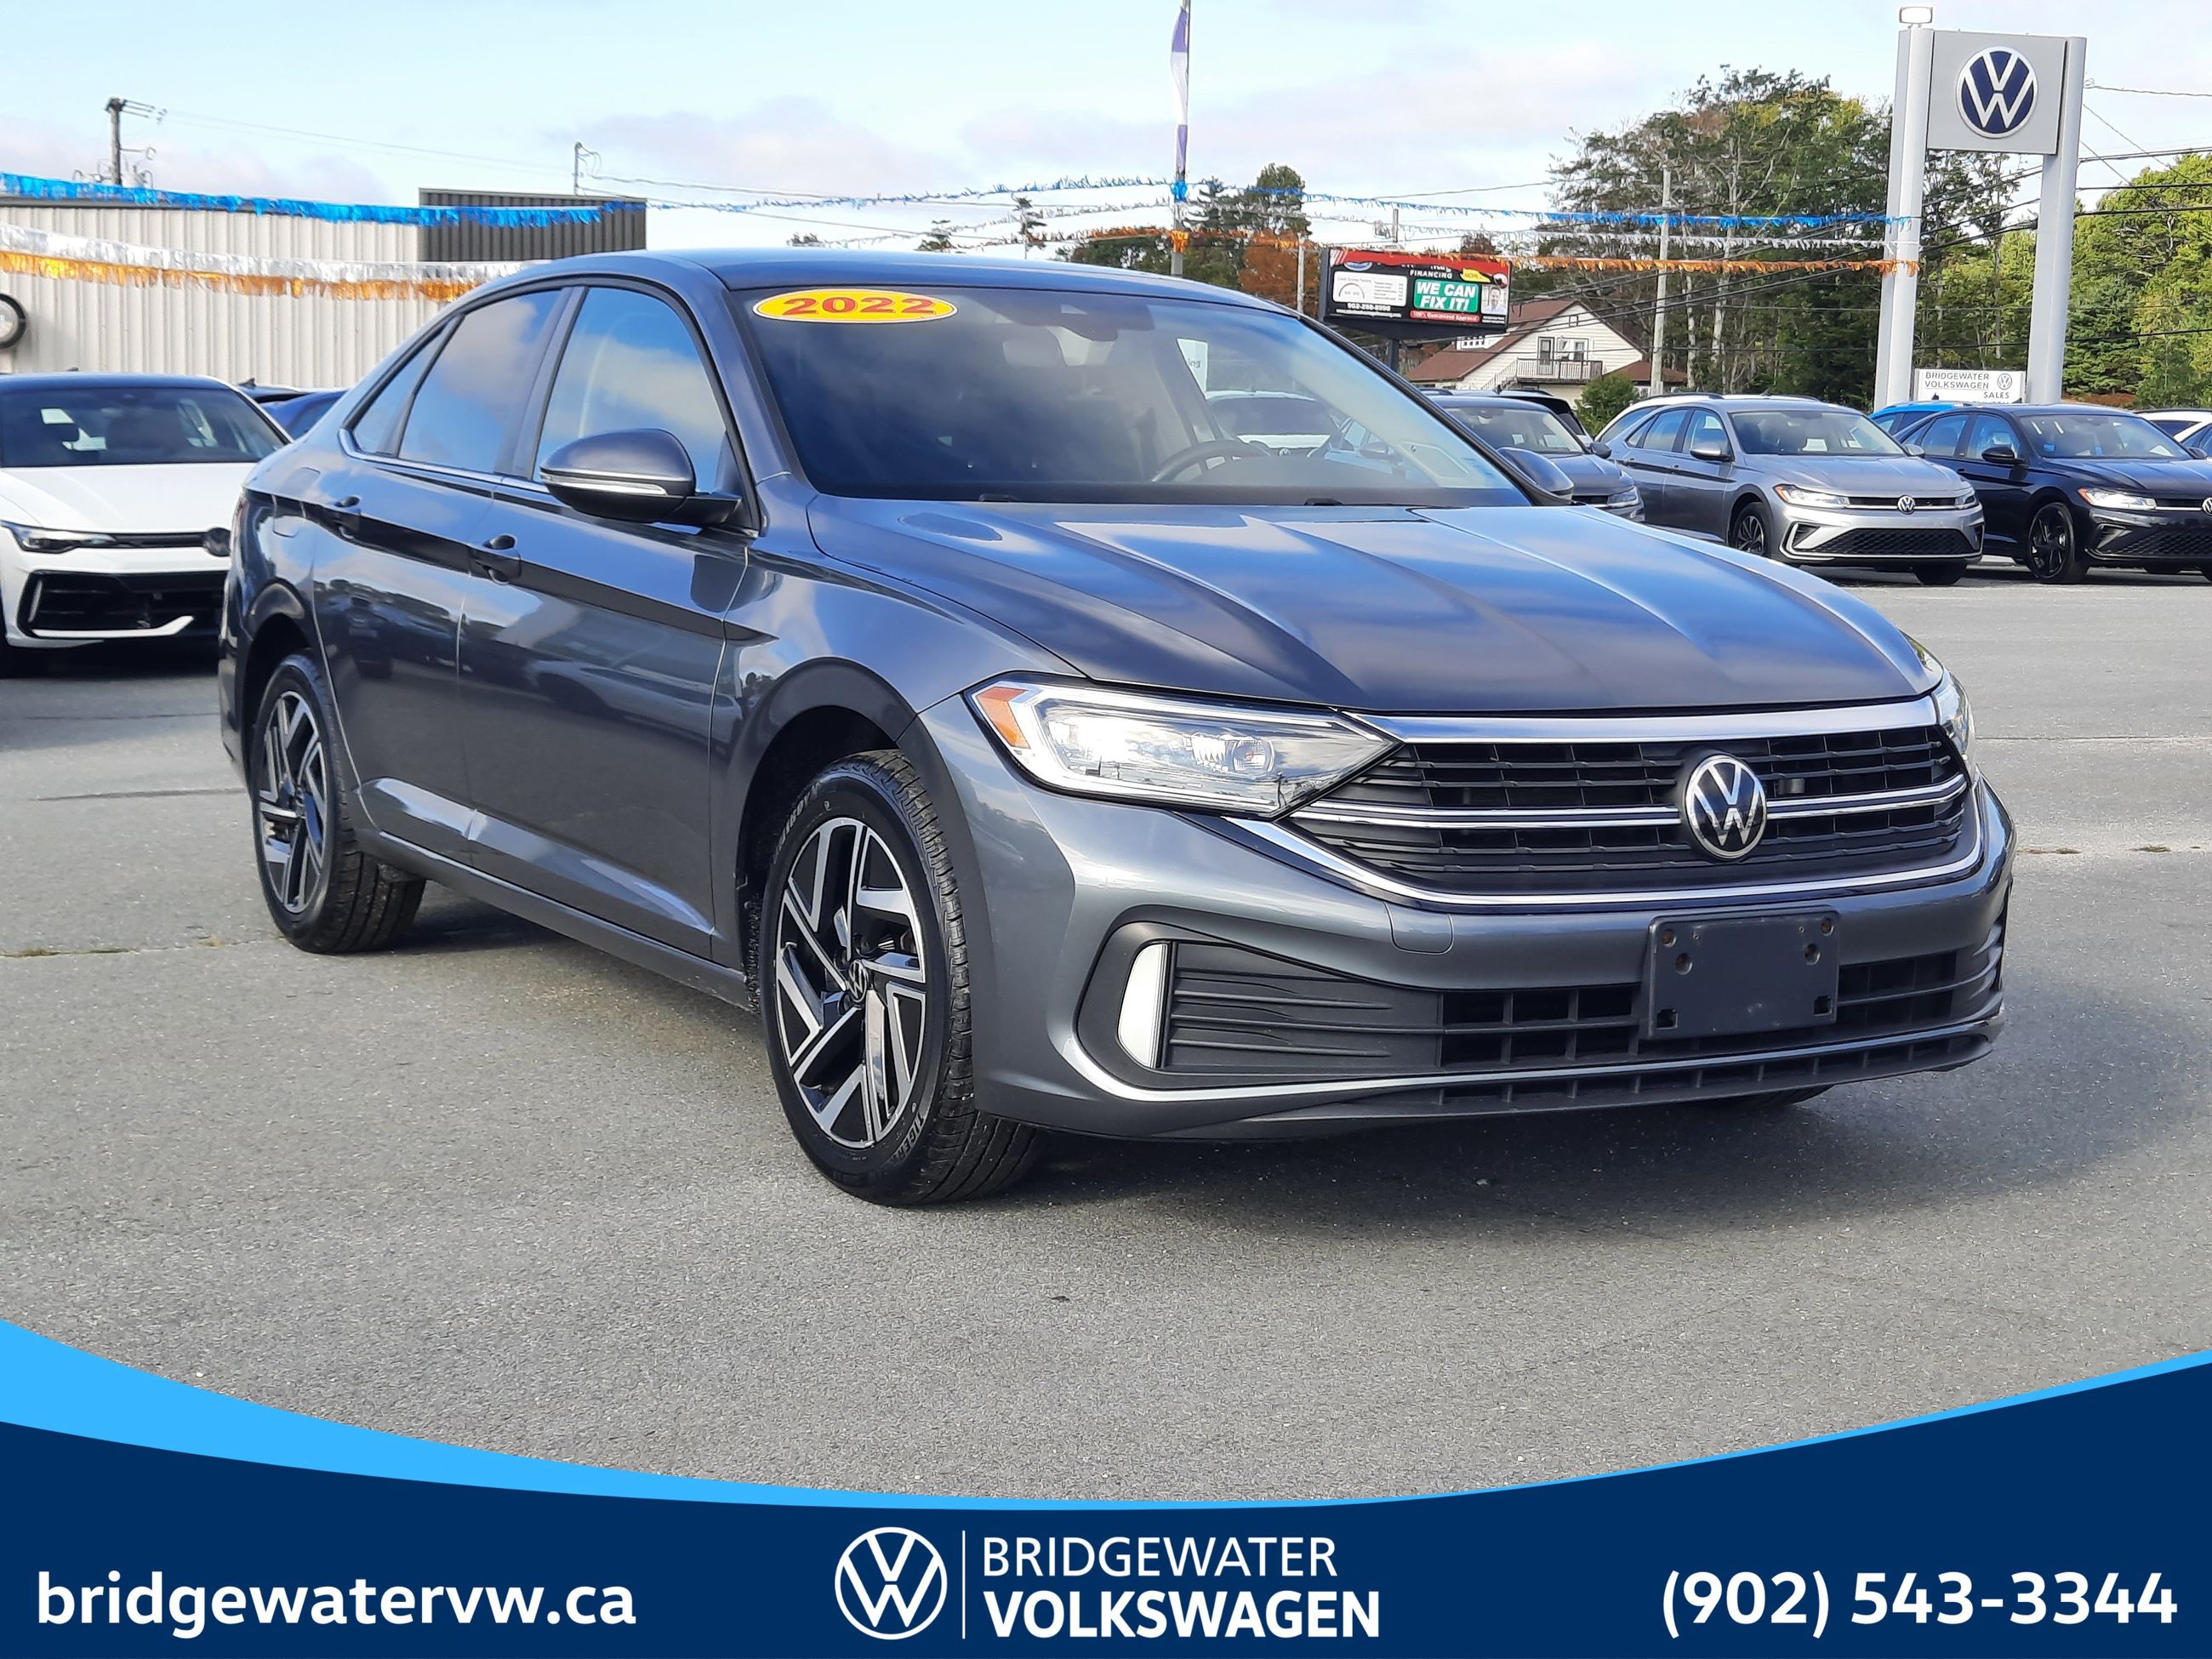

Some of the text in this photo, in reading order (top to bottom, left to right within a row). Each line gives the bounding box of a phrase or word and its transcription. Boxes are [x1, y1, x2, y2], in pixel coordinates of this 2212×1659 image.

[1410, 269, 1452, 279] FINANCING
[1417, 282, 1441, 295] WE
[1445, 283, 1476, 298] CAN
[783, 297, 937, 316] 2022
[1420, 295, 1470, 311] FIX IT!
[1925, 372, 1989, 381] BRIDGEWATER
[1924, 380, 1989, 390] VOLKSWAGEN
